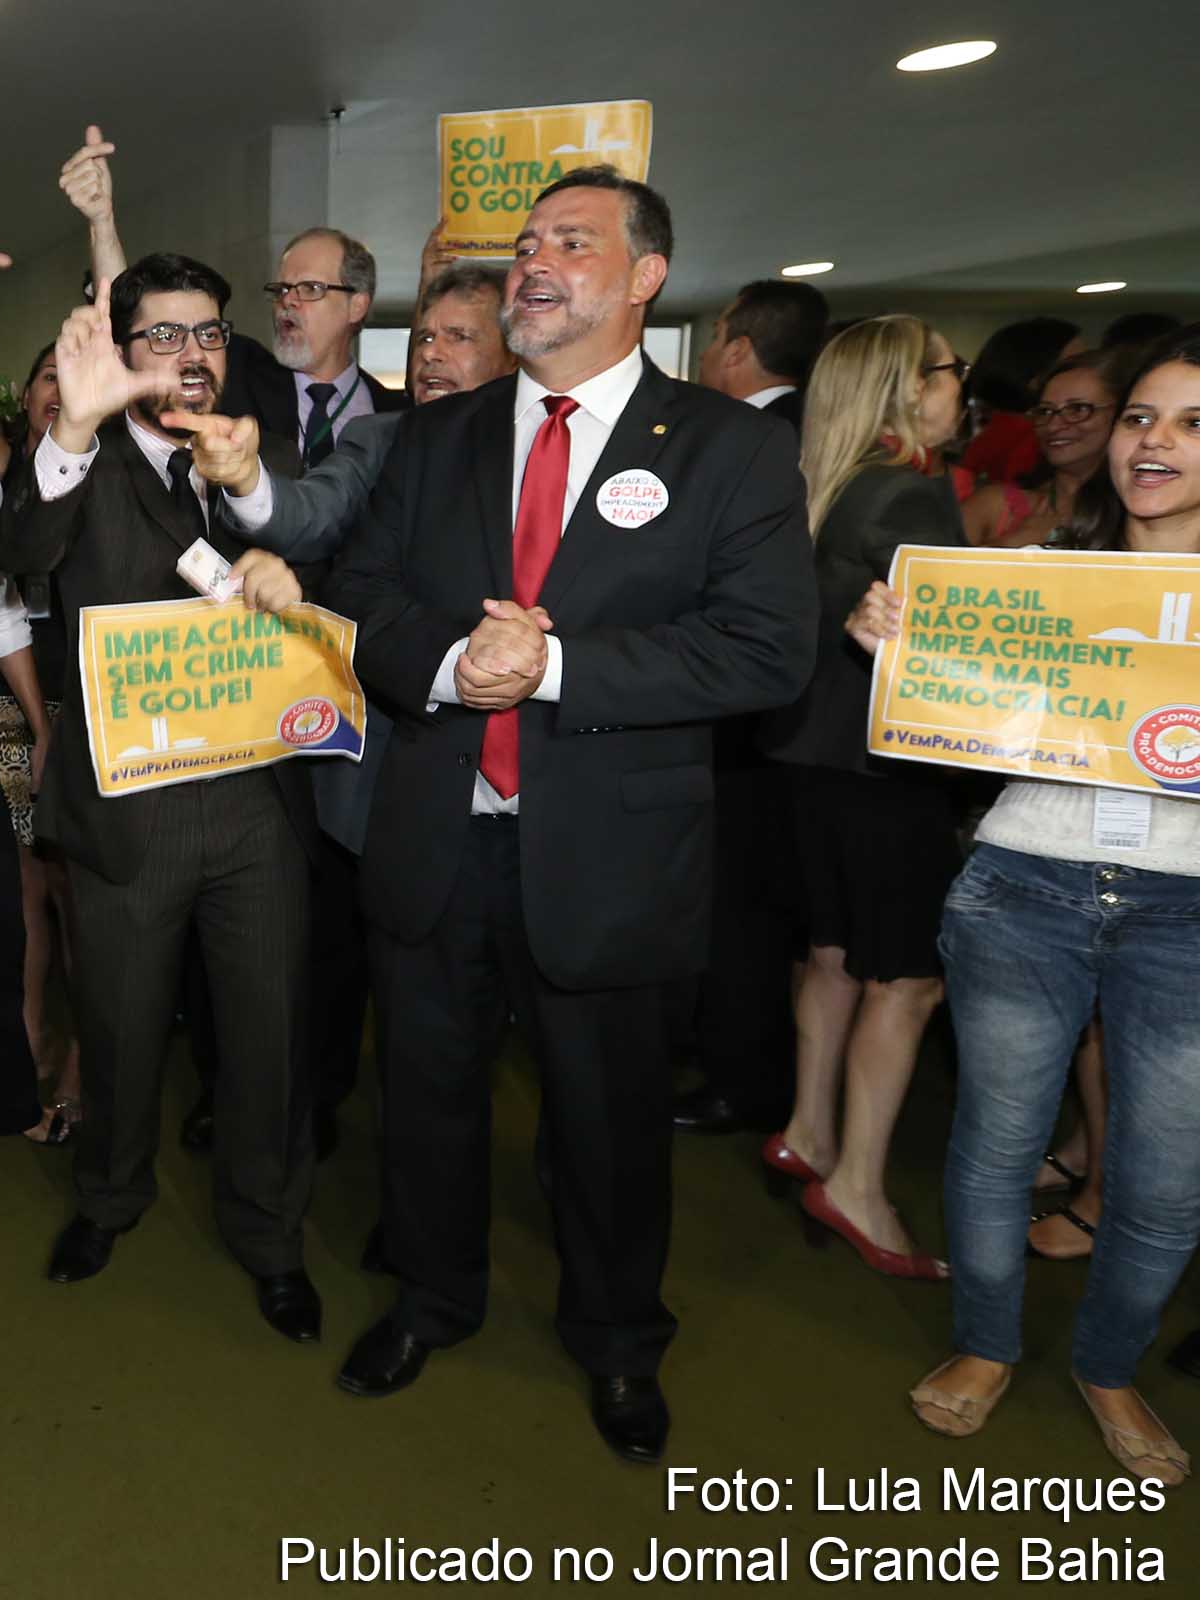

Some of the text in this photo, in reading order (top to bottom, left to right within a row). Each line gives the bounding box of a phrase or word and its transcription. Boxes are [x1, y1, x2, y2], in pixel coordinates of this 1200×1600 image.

[450, 136, 506, 161] SOU
[450, 160, 562, 188] CONTRA
[450, 188, 544, 214] O GOL
[609, 486, 662, 500] GOLPE
[915, 583, 1046, 612] O BRASIL
[910, 606, 1073, 638] NÃO QUER
[107, 642, 283, 688] SEM CRIME
[909, 631, 1136, 669] IMPEACHMENT.
[905, 656, 1071, 689] QUER MAIS
[139, 677, 253, 715] GOLPE!
[898, 680, 1126, 721] DEMOCRACIA!
[1158, 713, 1200, 727] COMIT
